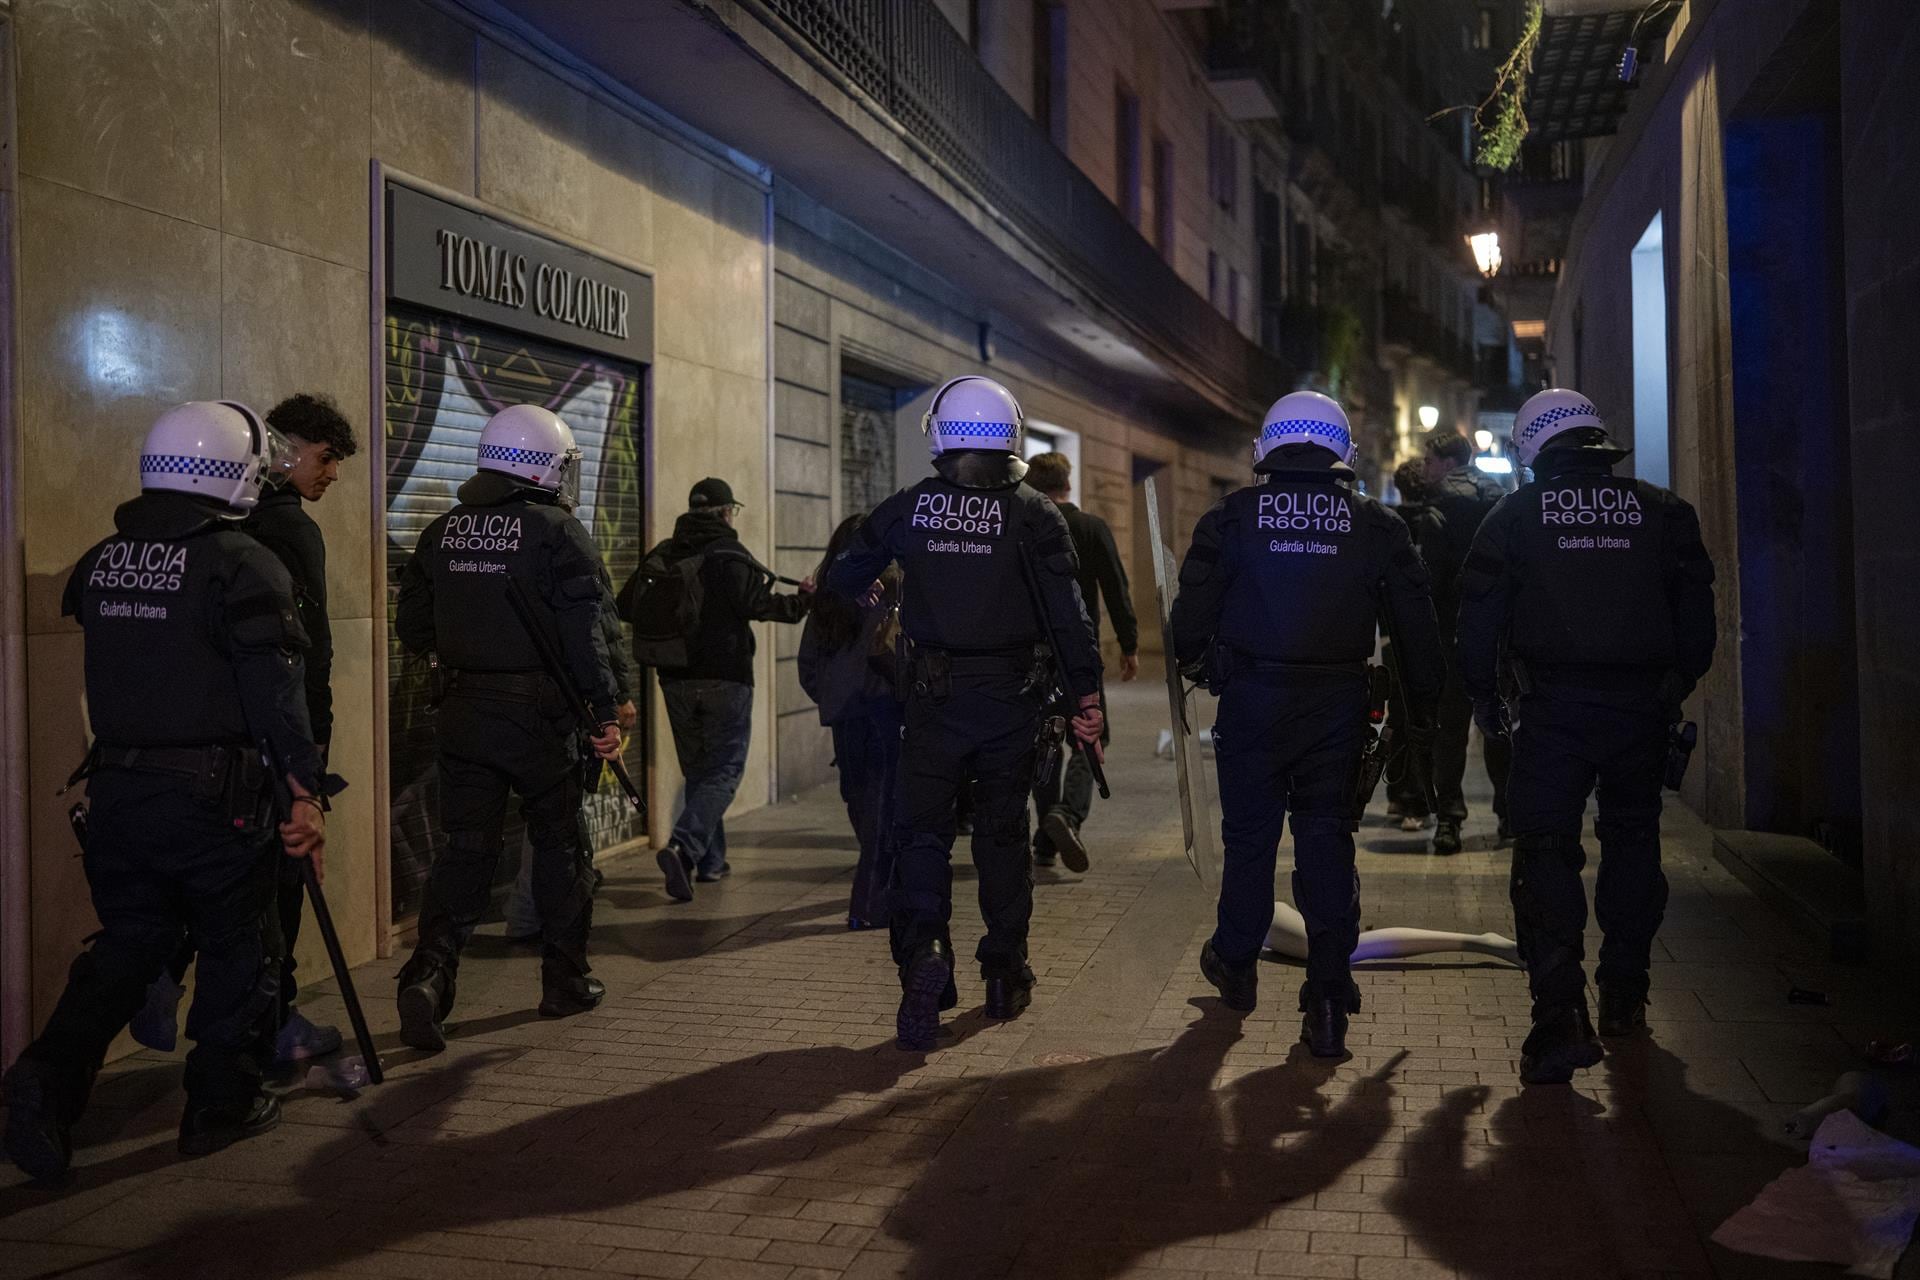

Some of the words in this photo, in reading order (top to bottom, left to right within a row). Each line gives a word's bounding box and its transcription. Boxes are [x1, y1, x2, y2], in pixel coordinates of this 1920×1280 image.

[438, 229, 527, 308] TOMAS
[534, 263, 629, 339] COLOMER
[914, 493, 1003, 522] POLICIA
[1258, 492, 1352, 519] POLICIA
[1541, 487, 1641, 511] POLICIA
[443, 514, 522, 538] POLICIA
[961, 541, 992, 554] Urbana
[1306, 541, 1338, 555] Urbana
[1597, 535, 1631, 549] Urbana
[95, 541, 188, 574] POLICIA
[134, 602, 167, 620] Urbana
